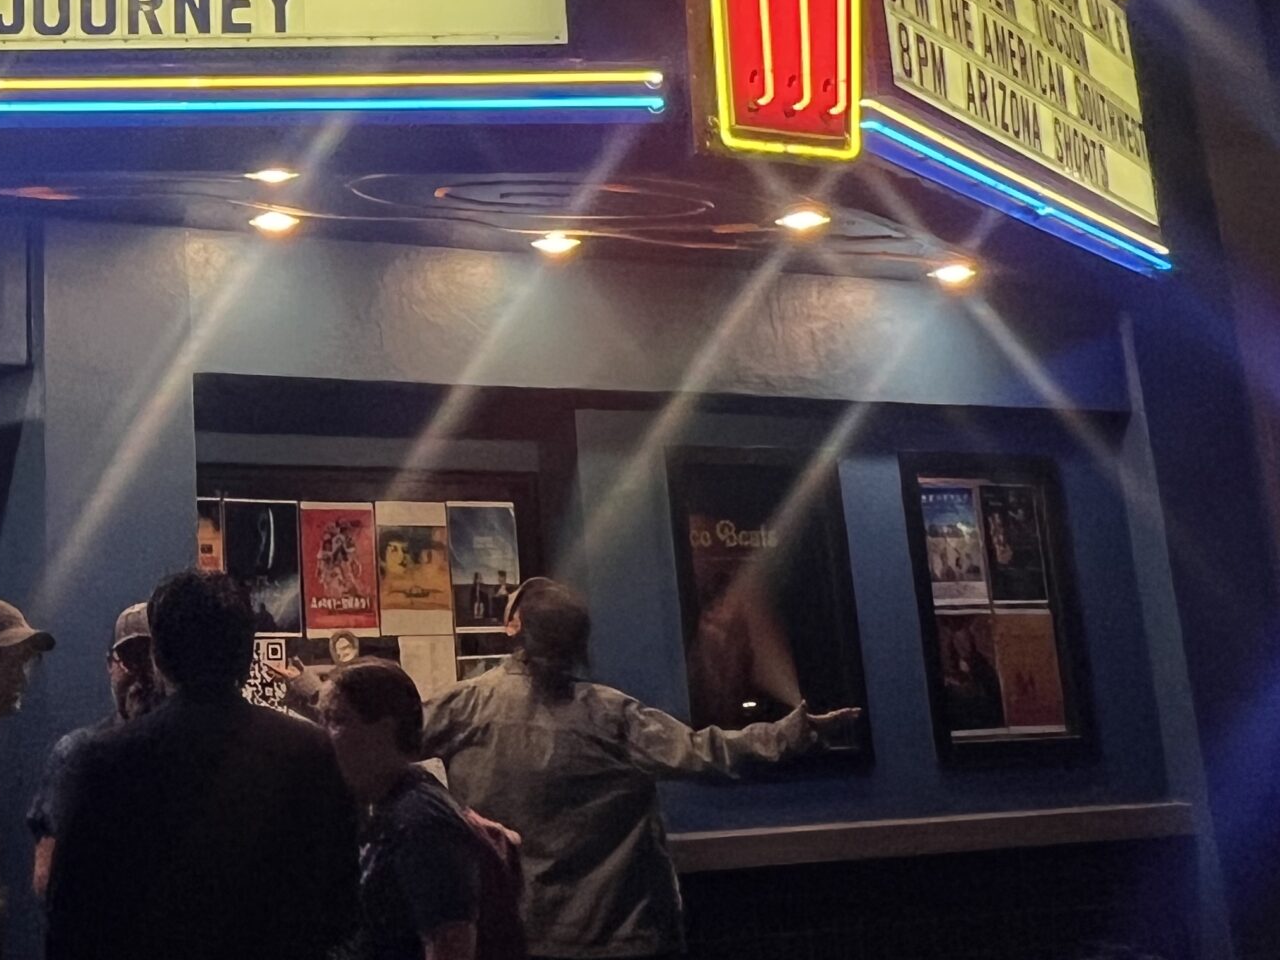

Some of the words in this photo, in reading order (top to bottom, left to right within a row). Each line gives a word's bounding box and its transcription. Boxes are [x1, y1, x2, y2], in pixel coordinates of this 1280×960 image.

[982, 12, 1067, 107] AMERICAN
[966, 62, 1042, 153] ARIZONA
[1054, 116, 1110, 192] SHORTS
